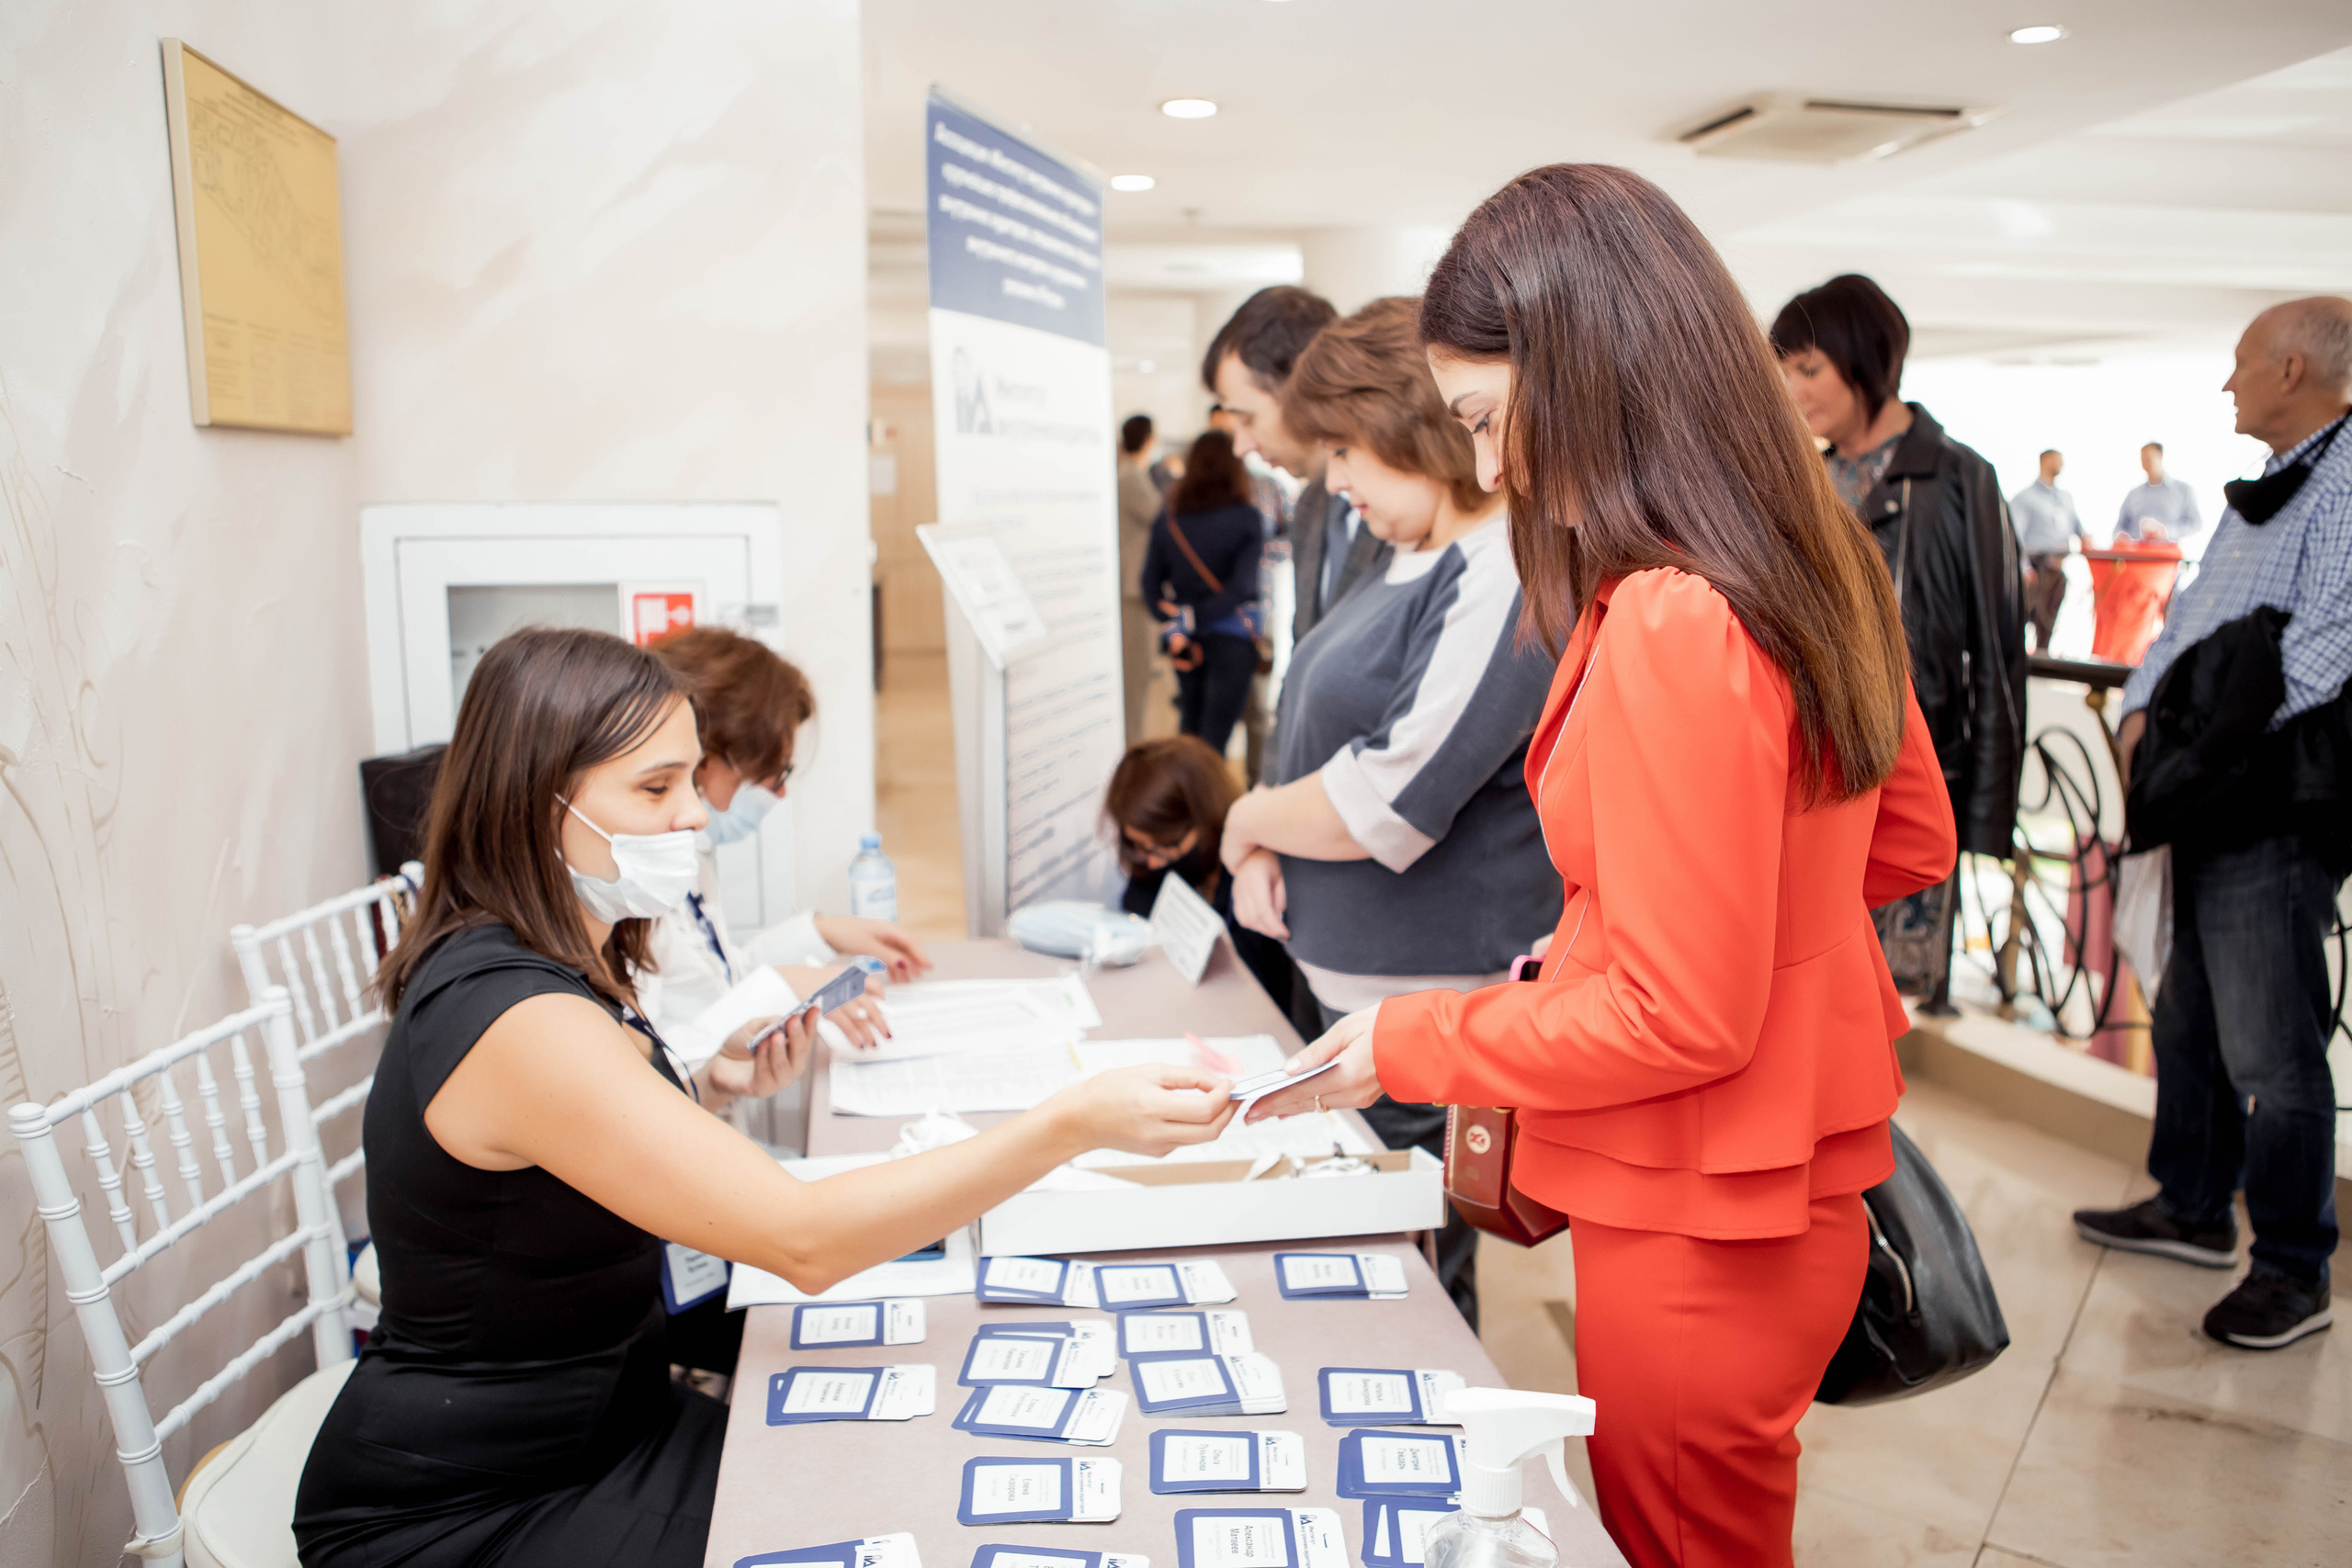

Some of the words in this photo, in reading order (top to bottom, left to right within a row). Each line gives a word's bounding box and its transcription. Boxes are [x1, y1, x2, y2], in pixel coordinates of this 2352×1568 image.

[832, 1382, 846, 1402] Алексей
[1025, 1398, 1040, 1413] Елена
[1199, 1443, 1209, 1472] Лукьянова
[1213, 1449, 1223, 1465] Ольга
[1408, 1448, 1421, 1471] Дмитрий
[1008, 1472, 1019, 1502] Сидорова
[1022, 1478, 1033, 1495] Елена
[1231, 1528, 1239, 1554] Матвеев
[1244, 1525, 1254, 1558] Александр
